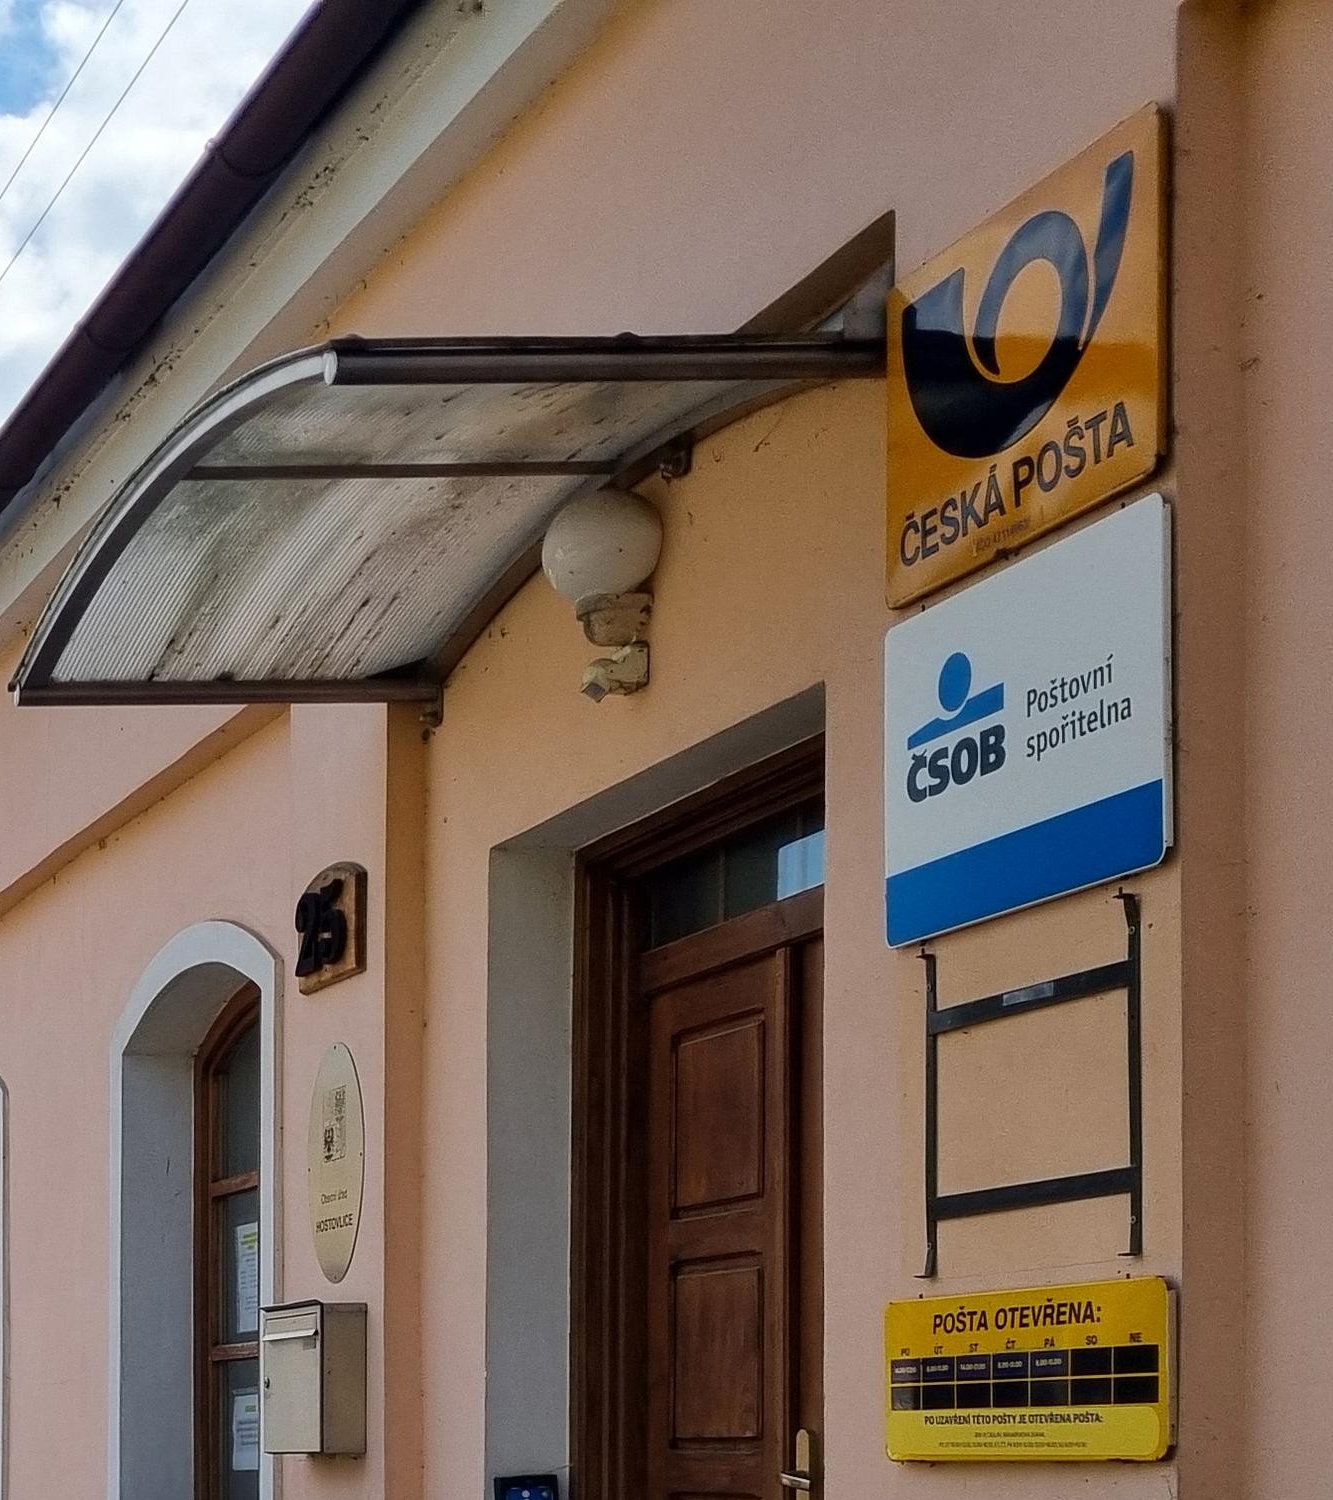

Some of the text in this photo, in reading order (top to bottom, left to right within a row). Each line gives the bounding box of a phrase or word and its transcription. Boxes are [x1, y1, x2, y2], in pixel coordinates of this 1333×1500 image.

[900, 401, 1135, 567] ČESKÁ POŠTA
[1026, 653, 1115, 719] Poštovní
[1025, 697, 1133, 762] spořitelna
[906, 723, 1007, 804] ČSOB
[932, 1298, 1102, 1335] POŠTA OTEVŘENA:
[968, 1343, 979, 1353] ST
[1043, 1337, 1055, 1348] PÁ
[1085, 1335, 1098, 1346] SO
[1129, 1332, 1143, 1343] NE
[924, 1411, 1103, 1425] PO UZAVŘENÍ TÉTO POŠTY JE OTEVŘENA POŠTA:
